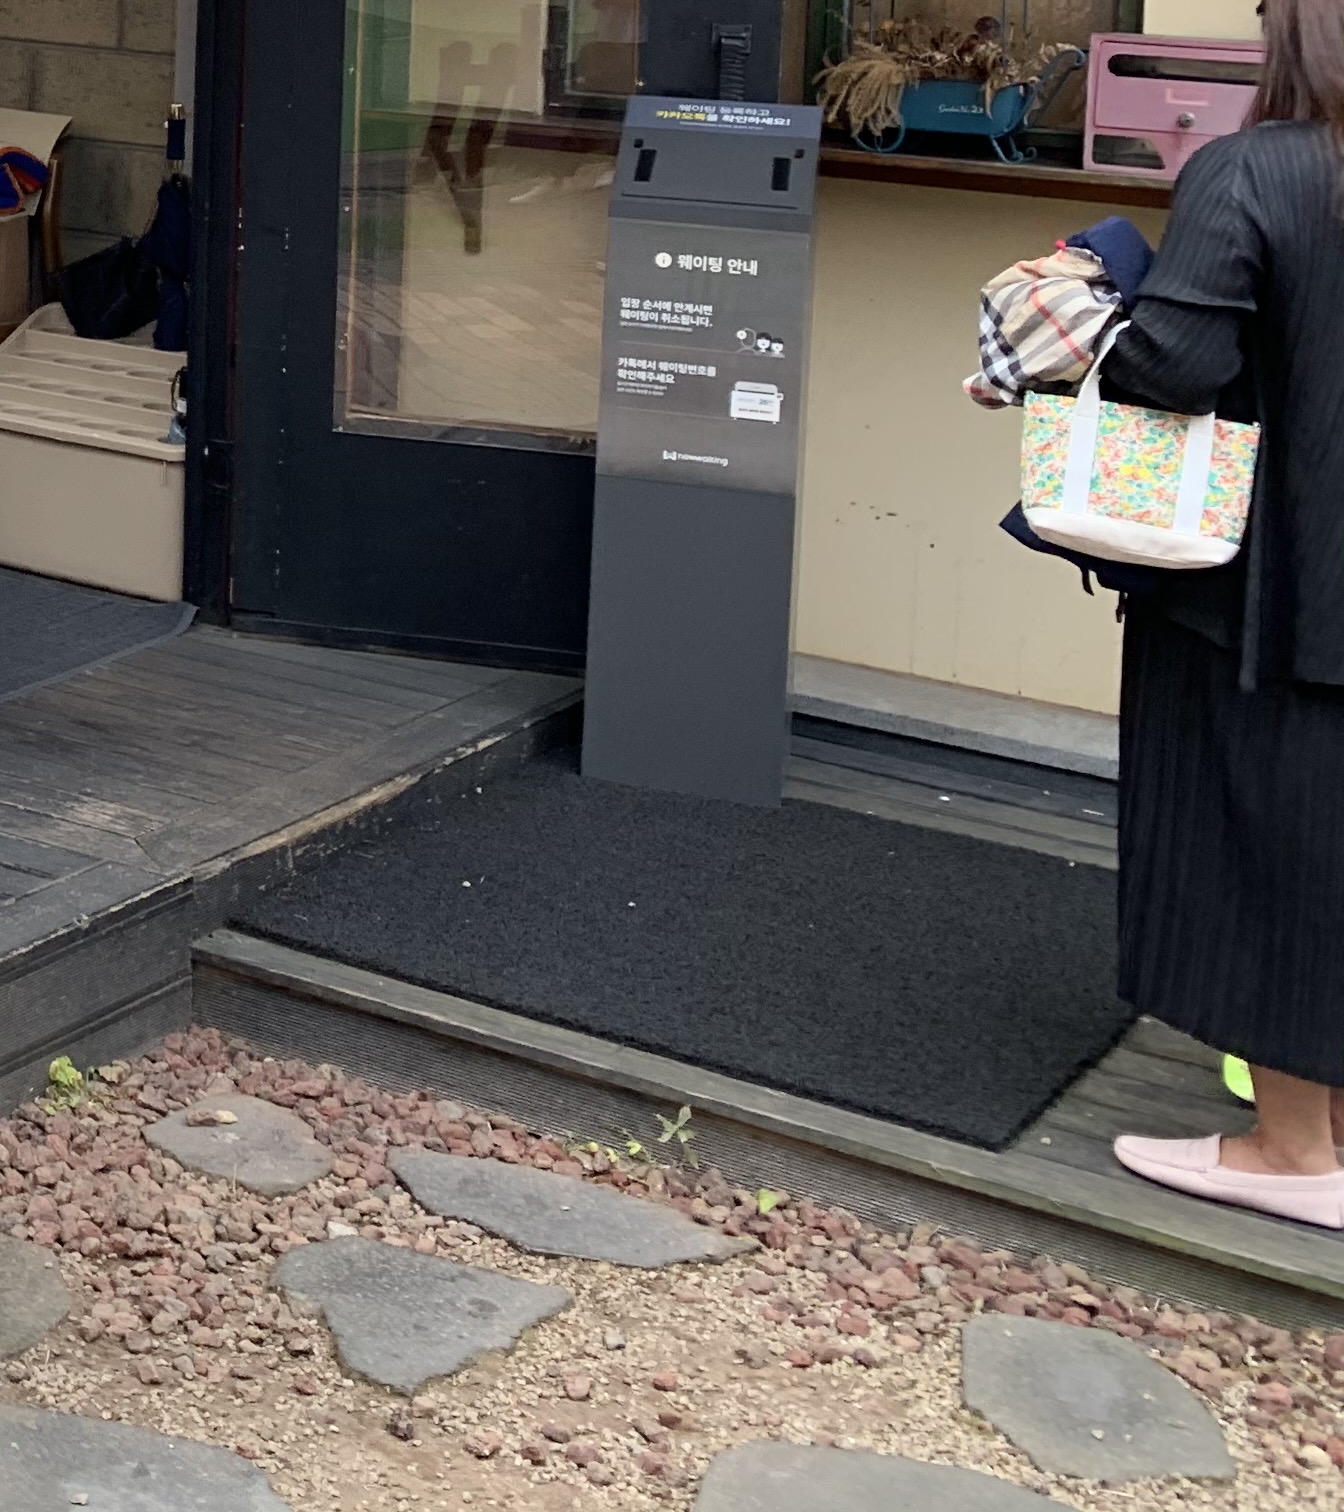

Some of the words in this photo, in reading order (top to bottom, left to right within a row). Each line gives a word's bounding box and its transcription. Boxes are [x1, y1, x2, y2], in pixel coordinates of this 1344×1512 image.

[677, 254, 723, 273] 웨이팅
[727, 258, 758, 276] 안내
[620, 296, 641, 309] 입장
[642, 299, 672, 312] 순서에
[673, 302, 713, 316] 안계시면
[619, 309, 659, 323] 웨이팅이
[661, 313, 713, 328] 취소됩니다.
[617, 356, 657, 371] 카톡에서
[617, 369, 676, 384] 확인해주세요
